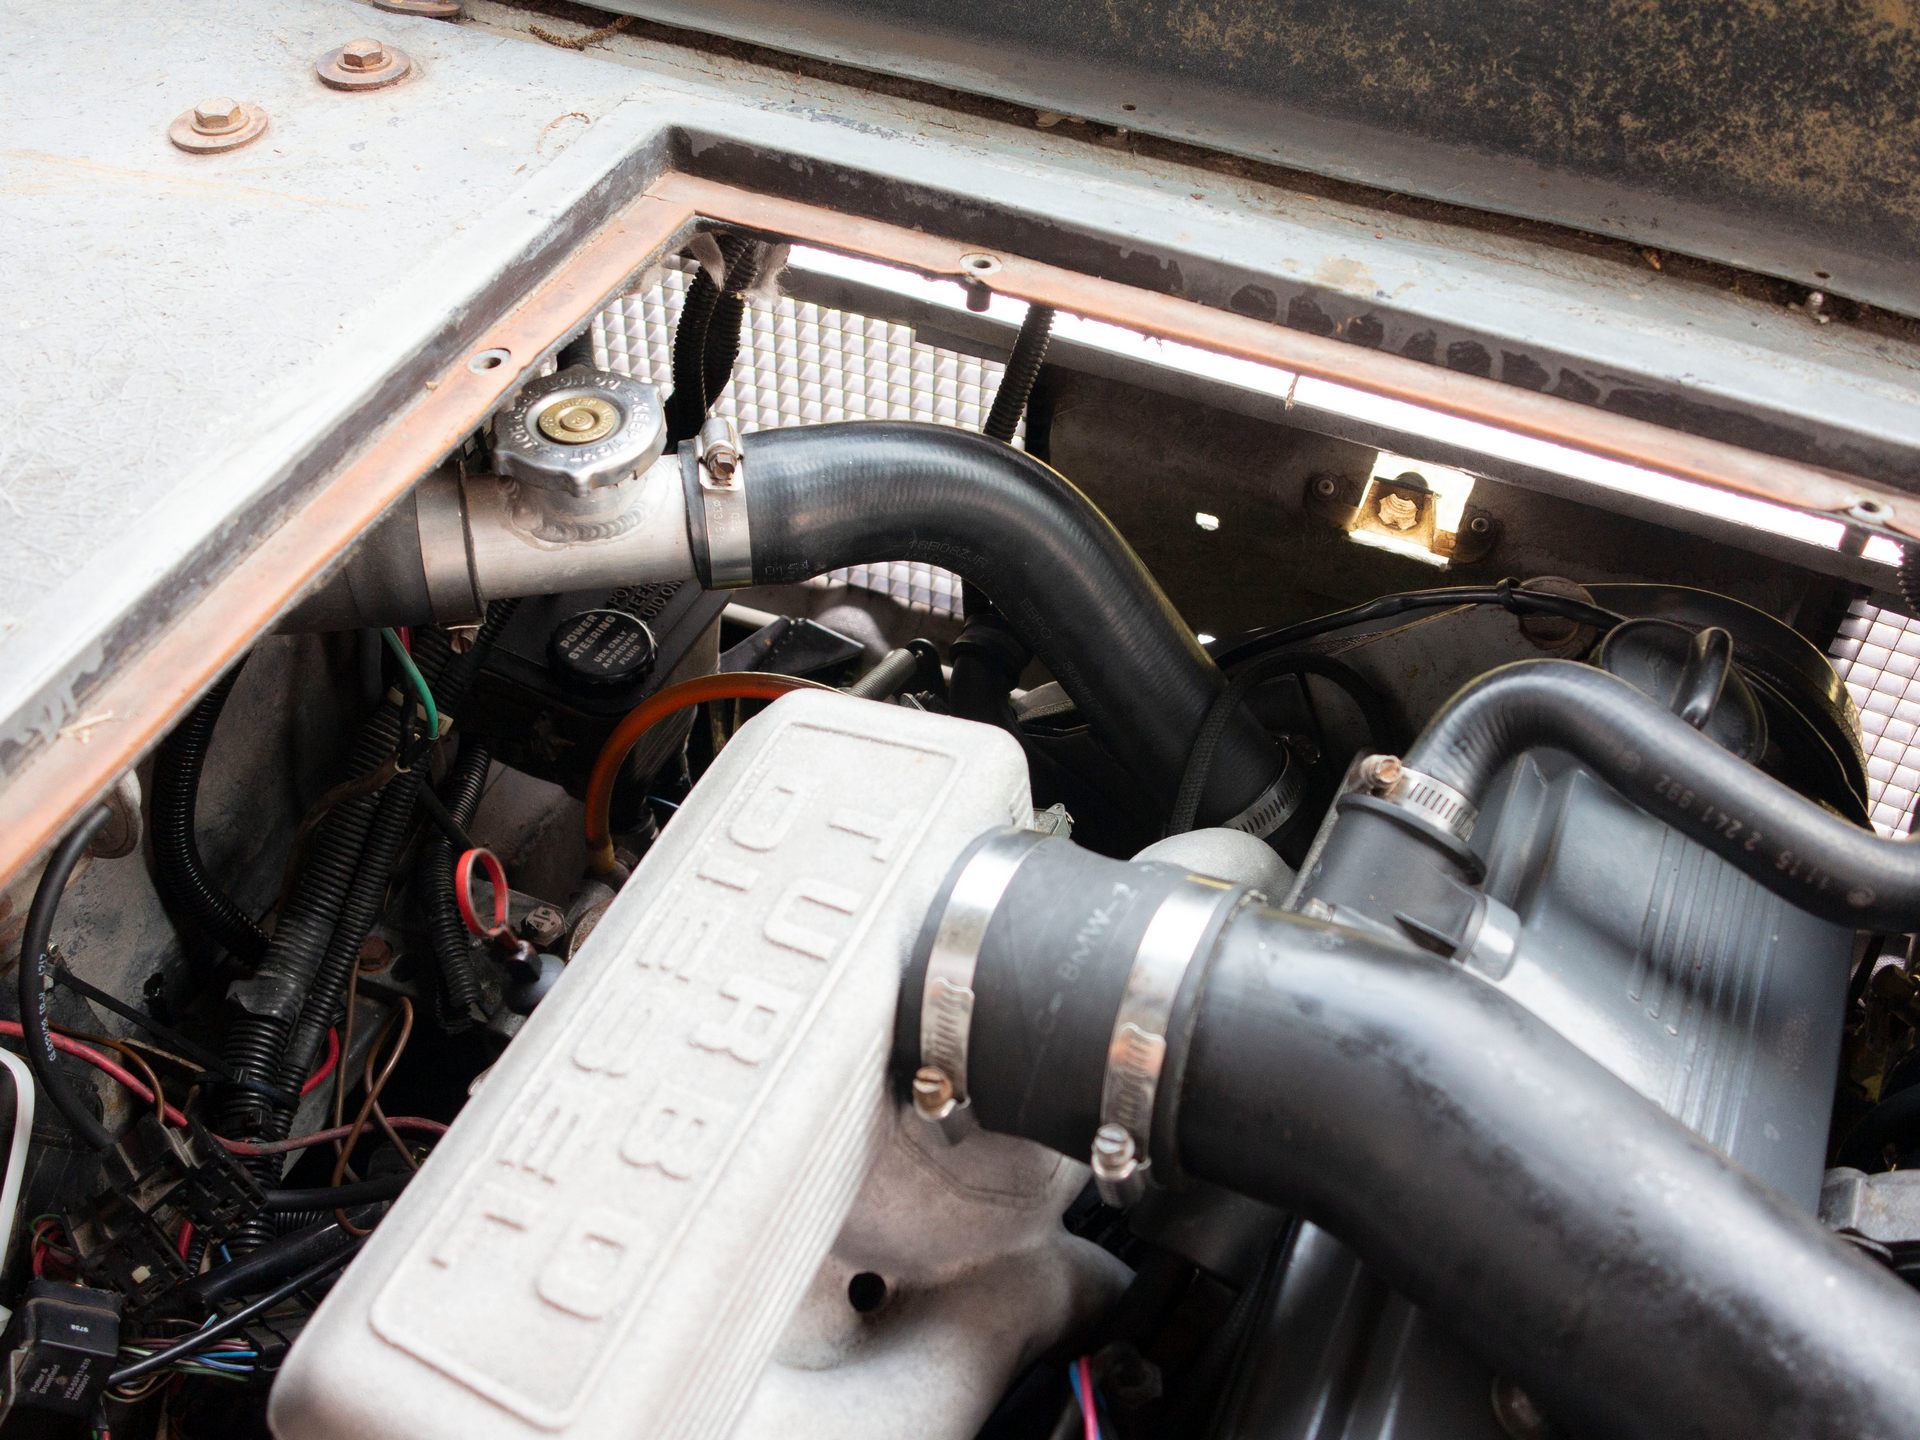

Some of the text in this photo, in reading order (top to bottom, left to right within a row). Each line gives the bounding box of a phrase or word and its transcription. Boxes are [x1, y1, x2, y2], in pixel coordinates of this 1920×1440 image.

[560, 614, 598, 649] POWER
[568, 615, 617, 660] STEERING
[593, 630, 628, 663] USE ONLY
[602, 633, 639, 669] APPROVED
[619, 645, 641, 665] FLUID
[428, 768, 806, 1270] DIESEL
[530, 803, 912, 1320] TURBO
